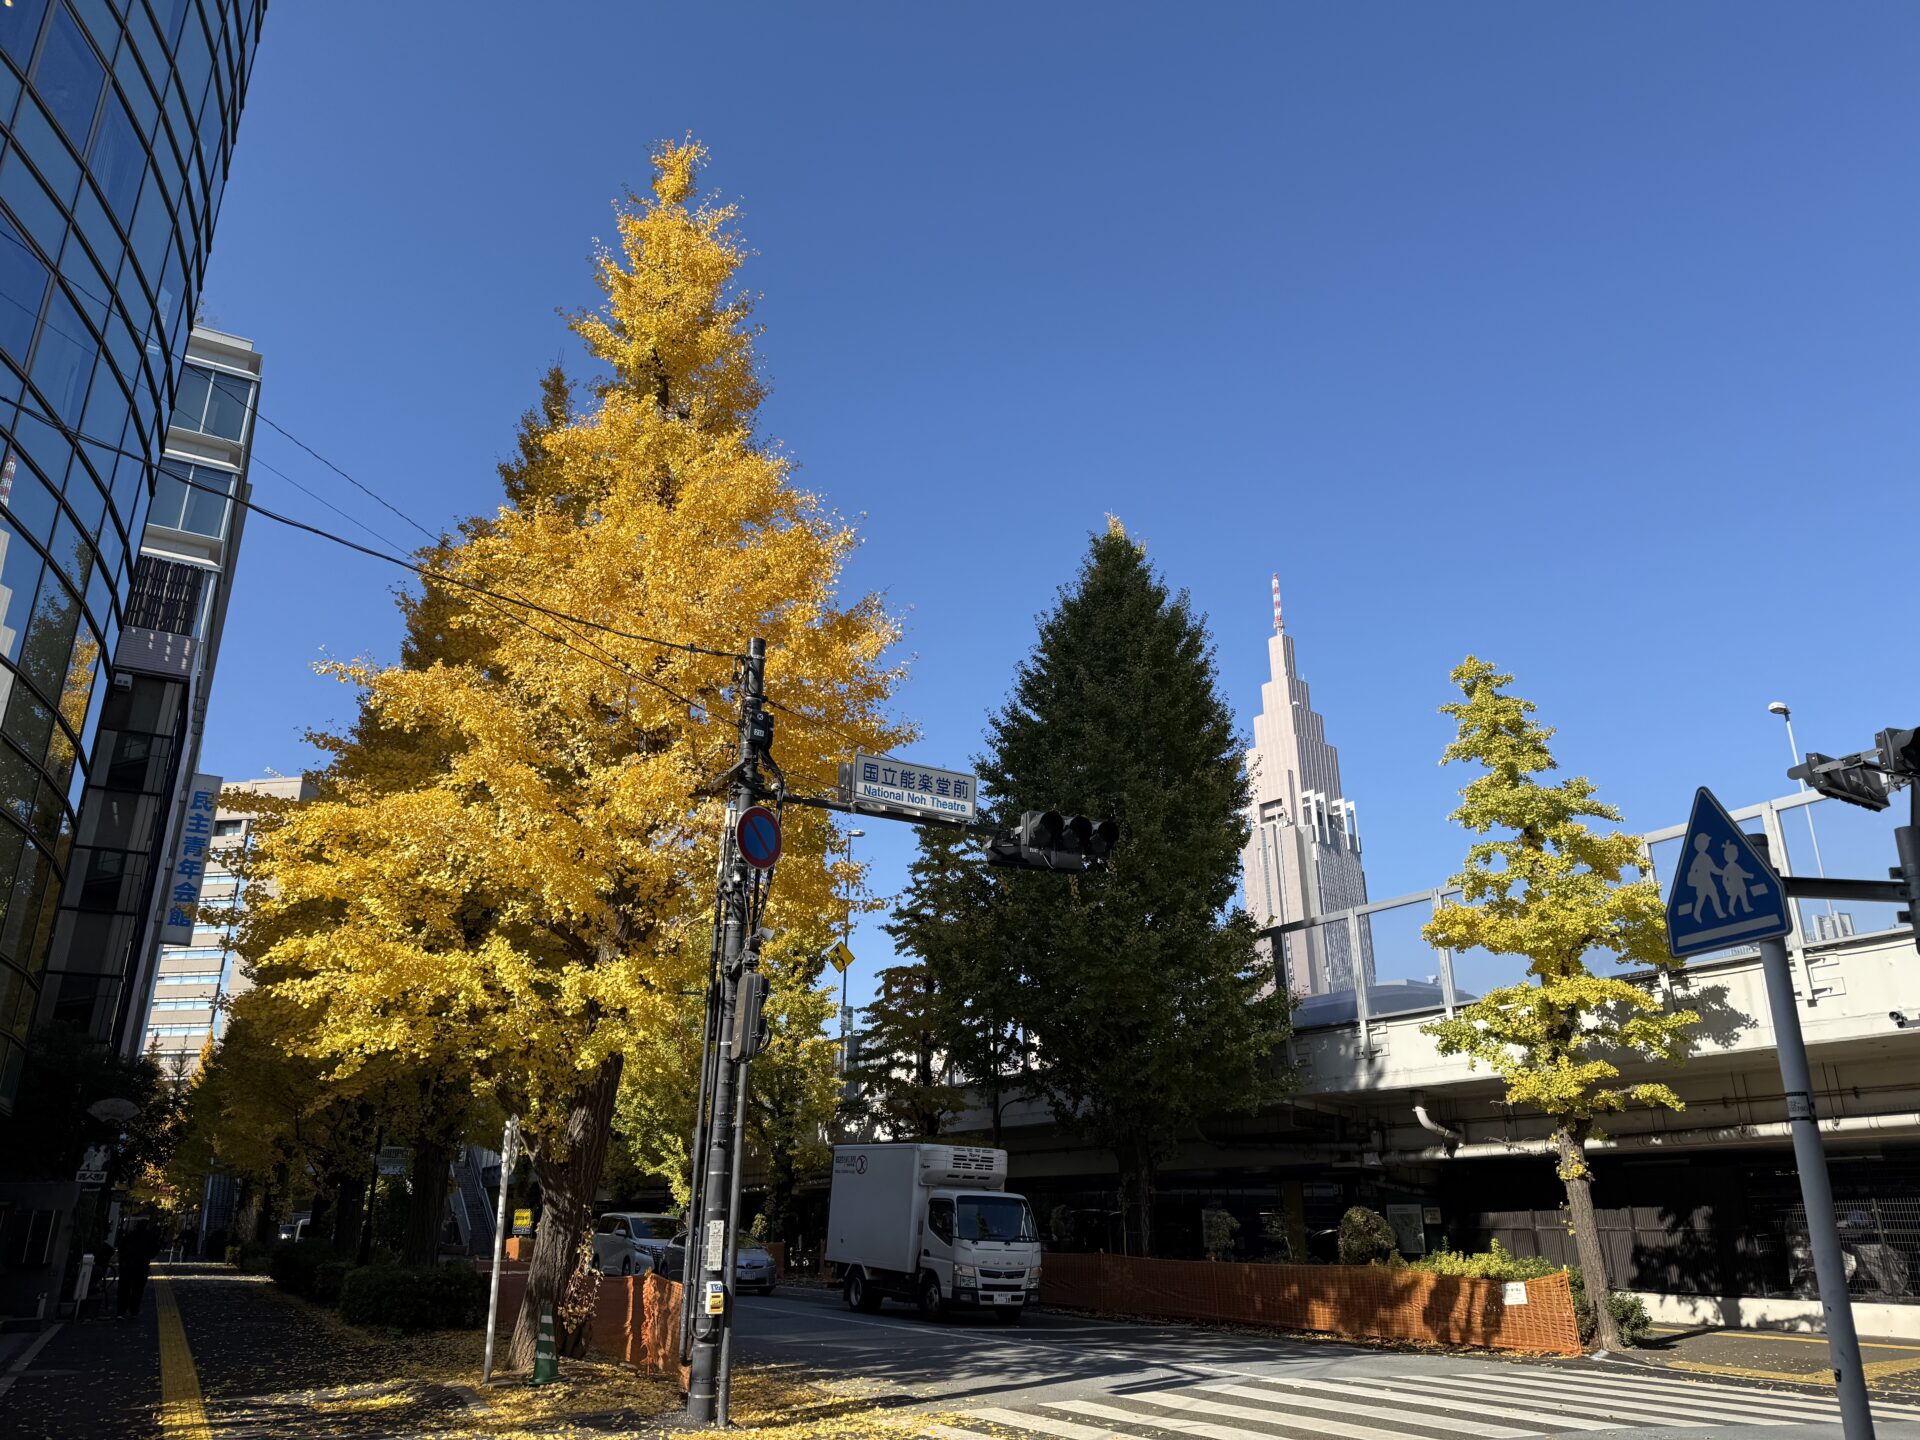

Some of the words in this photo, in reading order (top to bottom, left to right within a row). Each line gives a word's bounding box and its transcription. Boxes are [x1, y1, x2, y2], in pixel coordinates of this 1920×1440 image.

[864, 762, 969, 799] 国立能楽堂前
[864, 784, 904, 801] National
[907, 792, 927, 806] Noh
[930, 796, 967, 813] Theatre
